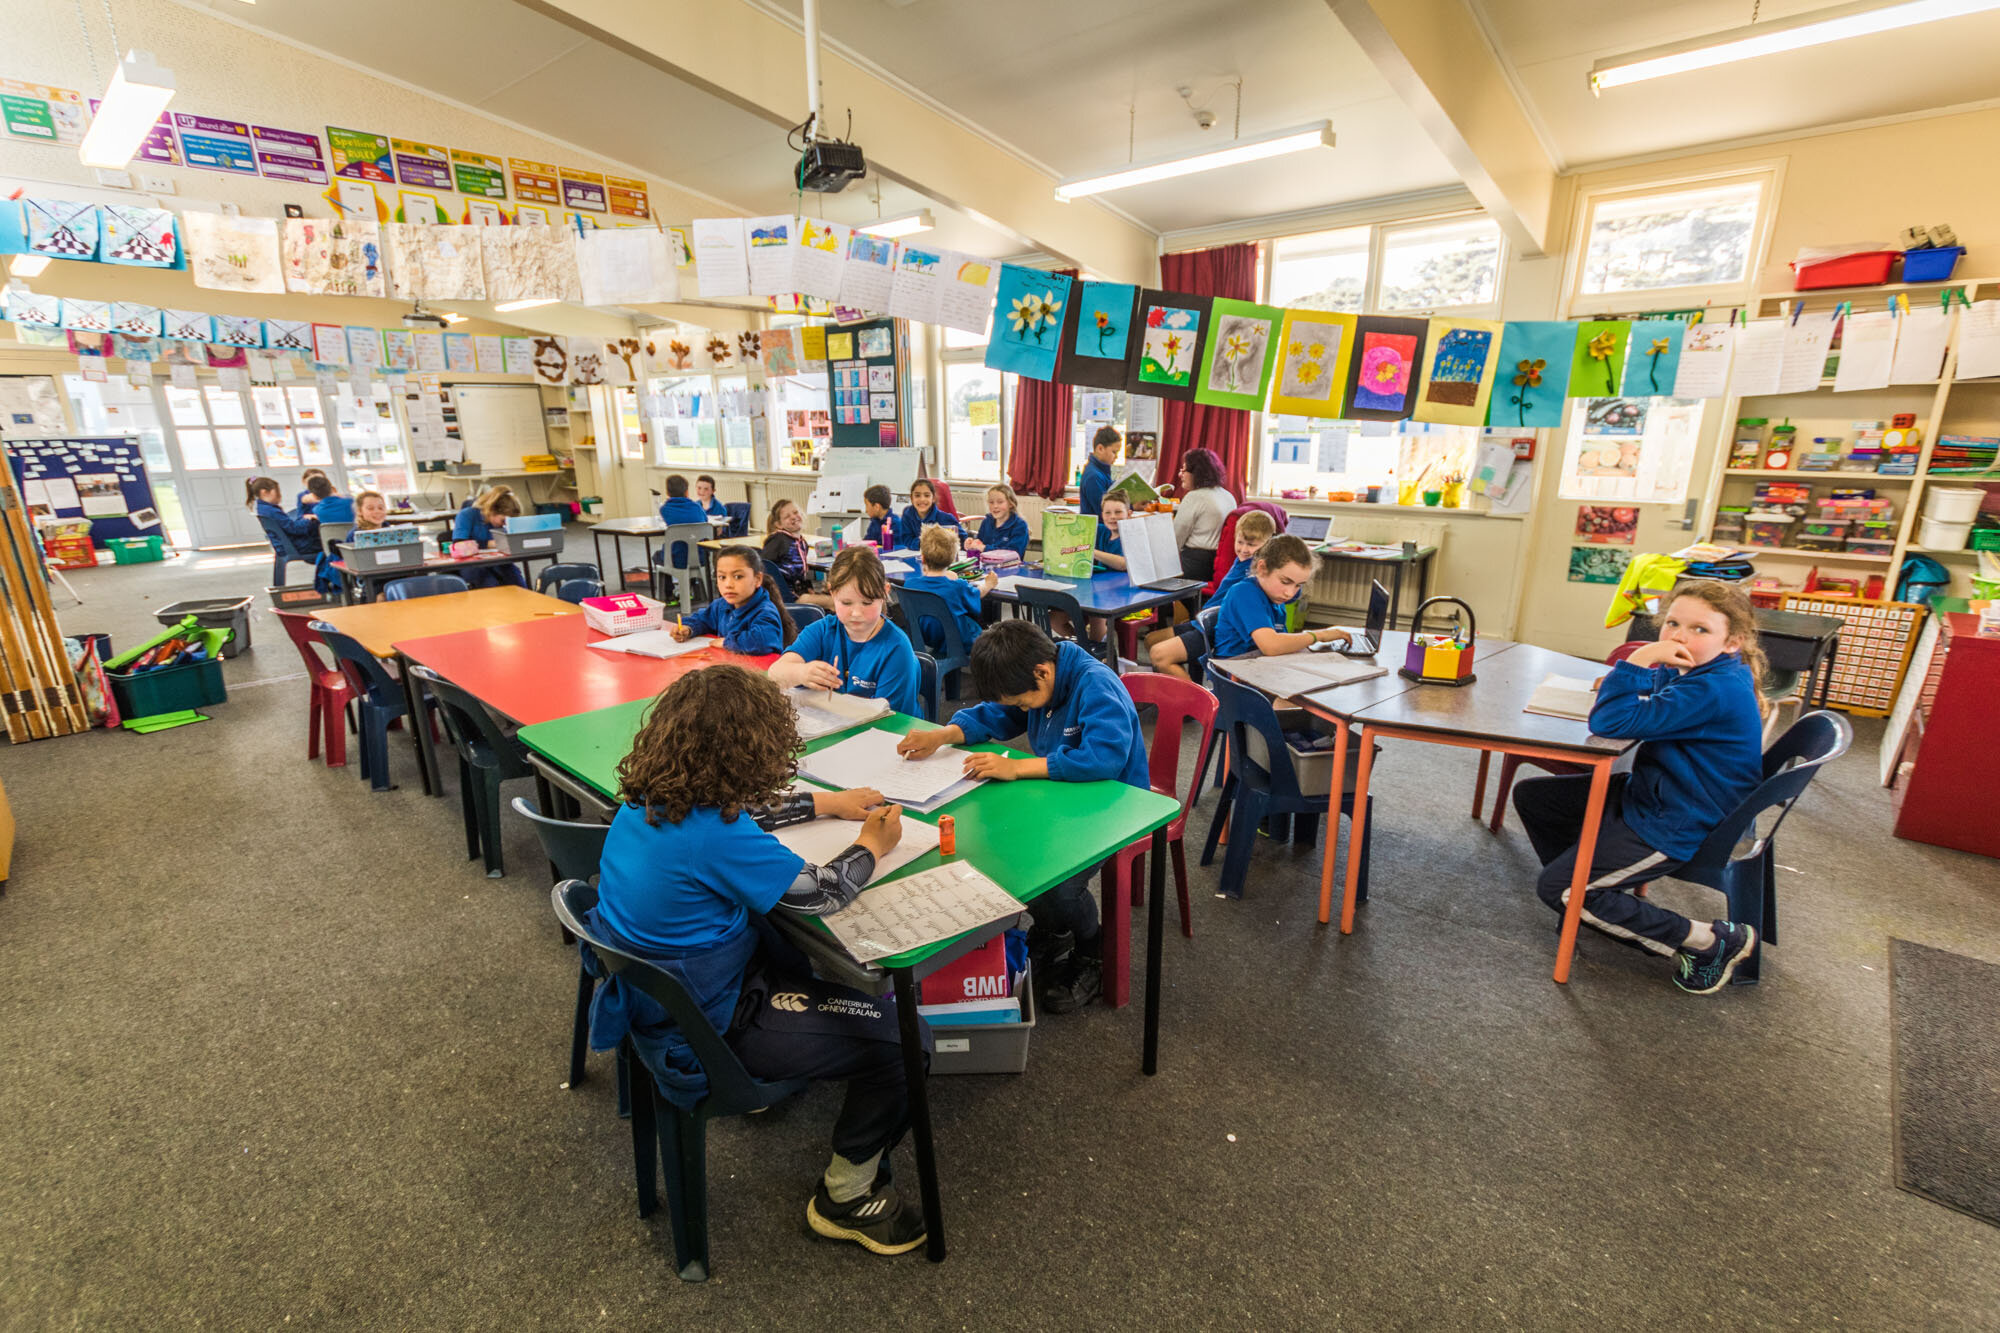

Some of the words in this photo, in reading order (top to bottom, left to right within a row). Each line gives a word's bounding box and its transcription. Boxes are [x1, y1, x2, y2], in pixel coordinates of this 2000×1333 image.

[333, 136, 376, 151] Spelling
[818, 1004, 829, 1012] OF
[830, 1005, 848, 1014] NEW
[848, 1008, 882, 1018] ZEALAND
[828, 998, 874, 1010] CANTERBURY
